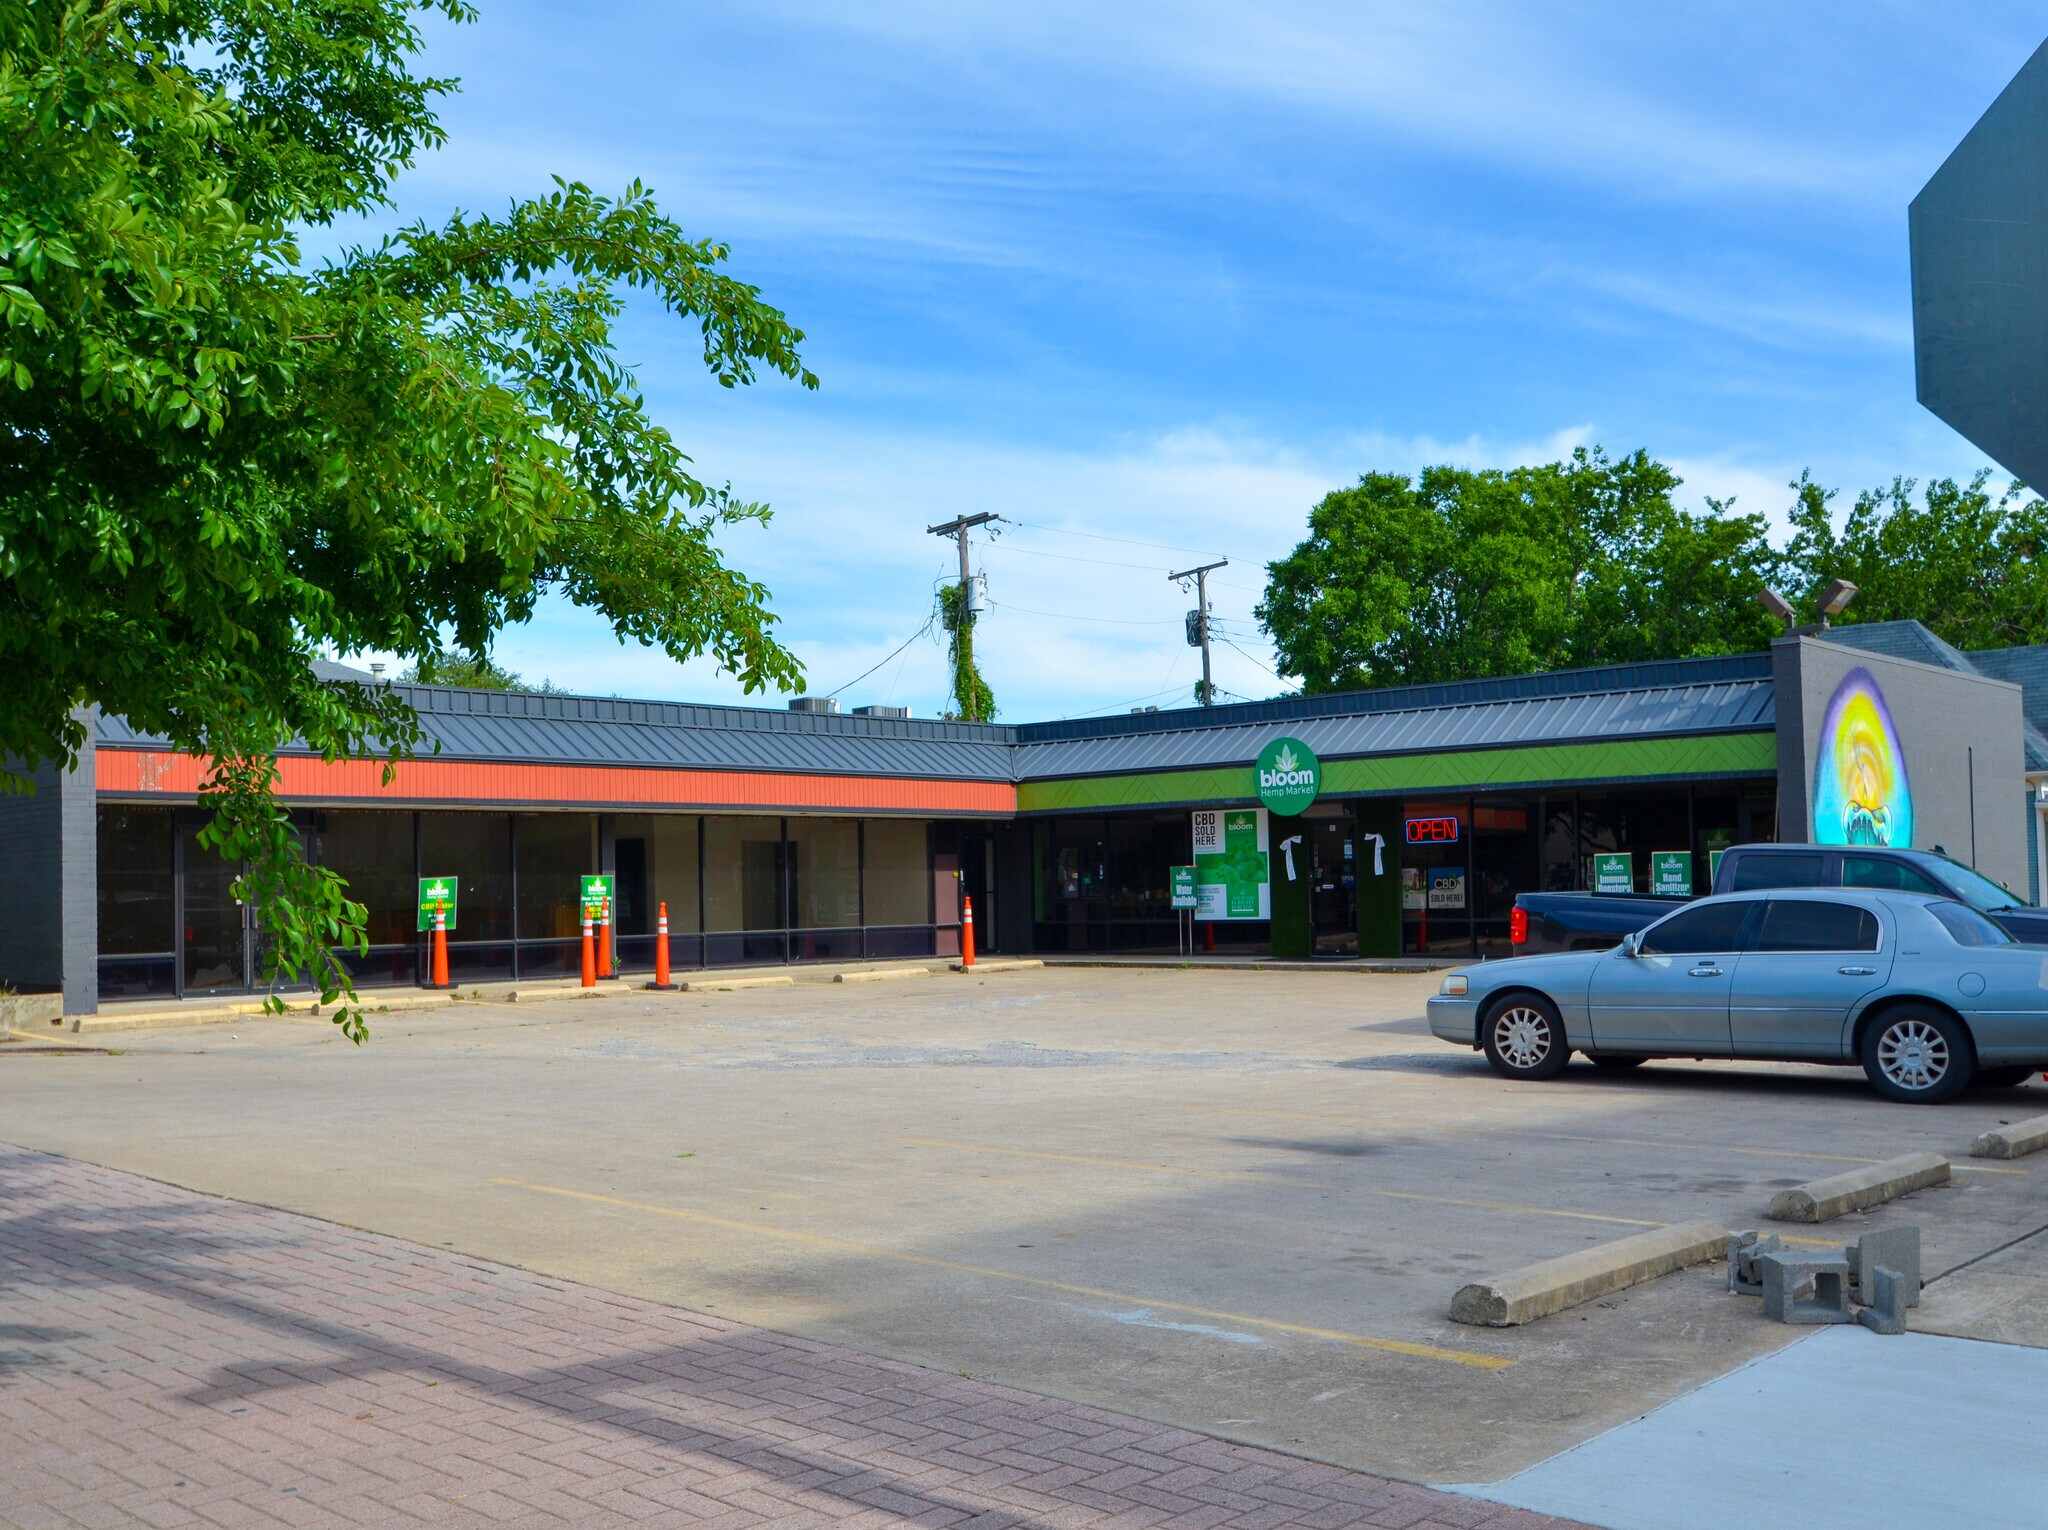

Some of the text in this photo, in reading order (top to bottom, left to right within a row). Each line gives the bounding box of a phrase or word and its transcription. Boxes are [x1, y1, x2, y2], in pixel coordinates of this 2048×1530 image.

[1260, 769, 1314, 788] bloom
[1261, 785, 1314, 797] Hemp Market
[1195, 813, 1215, 825] CBD
[1195, 825, 1216, 836] SOLD
[1229, 823, 1253, 831] bloom
[1408, 820, 1455, 841] OPEN
[1195, 835, 1216, 846] HERE
[1603, 863, 1623, 871] bloom
[1661, 861, 1683, 869] bloom
[1600, 875, 1628, 884] Immune
[1663, 874, 1682, 882] Hand
[1434, 878, 1457, 890] CBD
[1656, 882, 1689, 892] Sanitizer
[1176, 885, 1192, 895] Water
[1173, 896, 1197, 906] Available
[1431, 894, 1445, 903] SOLD
